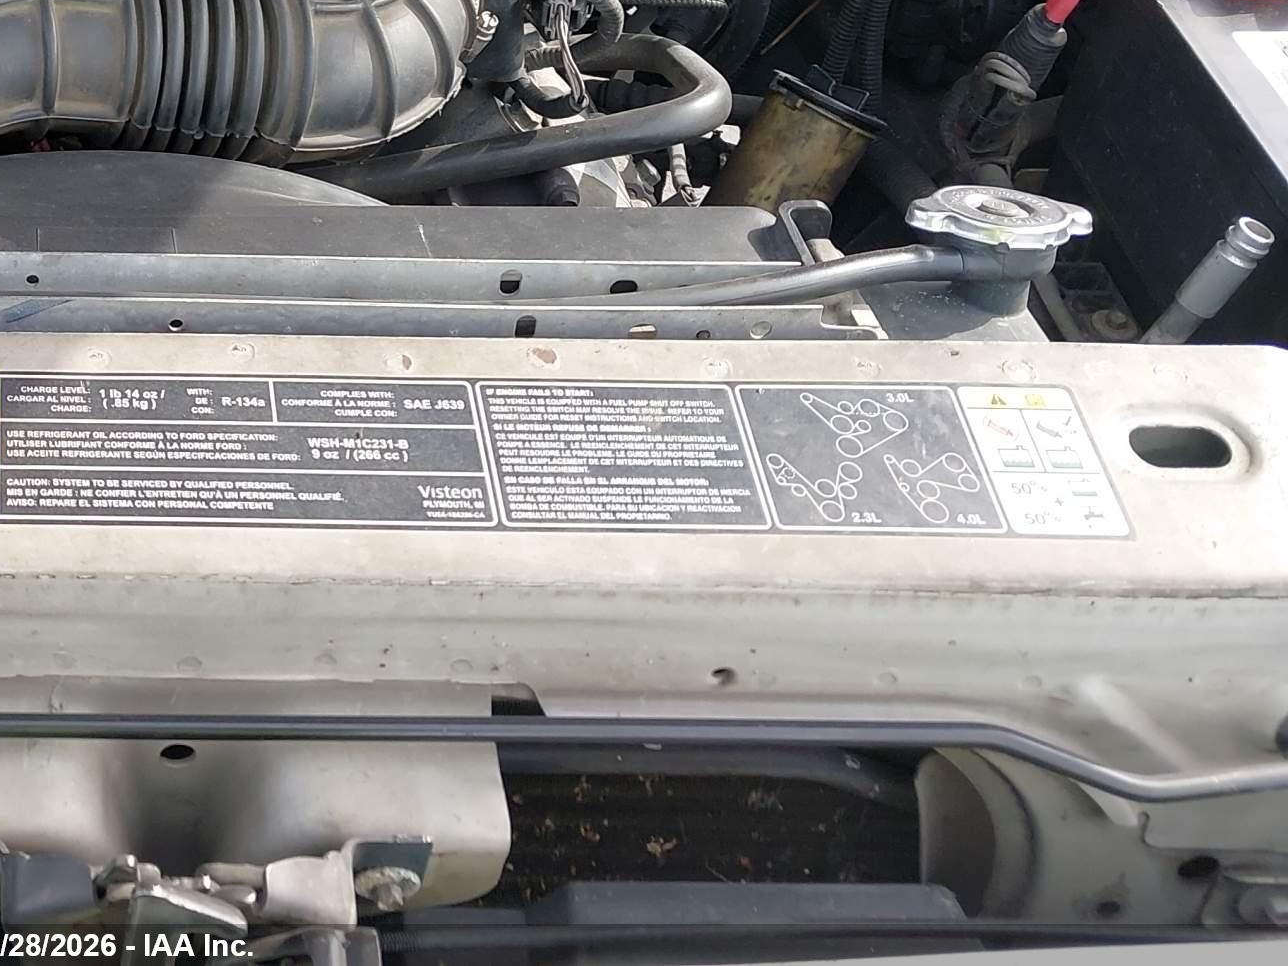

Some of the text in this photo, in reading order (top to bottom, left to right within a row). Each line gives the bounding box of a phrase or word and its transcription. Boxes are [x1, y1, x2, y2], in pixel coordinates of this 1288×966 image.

[60, 386, 90, 394] LEVEL:
[109, 389, 122, 398] lb
[126, 390, 140, 398] 14
[186, 388, 213, 396] WITH:
[221, 397, 265, 407] R-134a
[281, 399, 333, 407] CONFORME
[886, 393, 914, 403] 3.0L
[133, 399, 149, 409] kg
[403, 400, 465, 410] SAE J639
[335, 409, 373, 417] CUMPLE
[166, 432, 178, 440] TO
[312, 450, 319, 459] 9
[384, 452, 400, 460] cc
[53, 479, 90, 487] SYSTEM
[121, 480, 167, 488] SERVICED
[184, 481, 233, 489] QUALIFIED
[417, 485, 483, 499] Visteon
[851, 513, 882, 523] 2.3L
[957, 514, 986, 525] 4.0L
